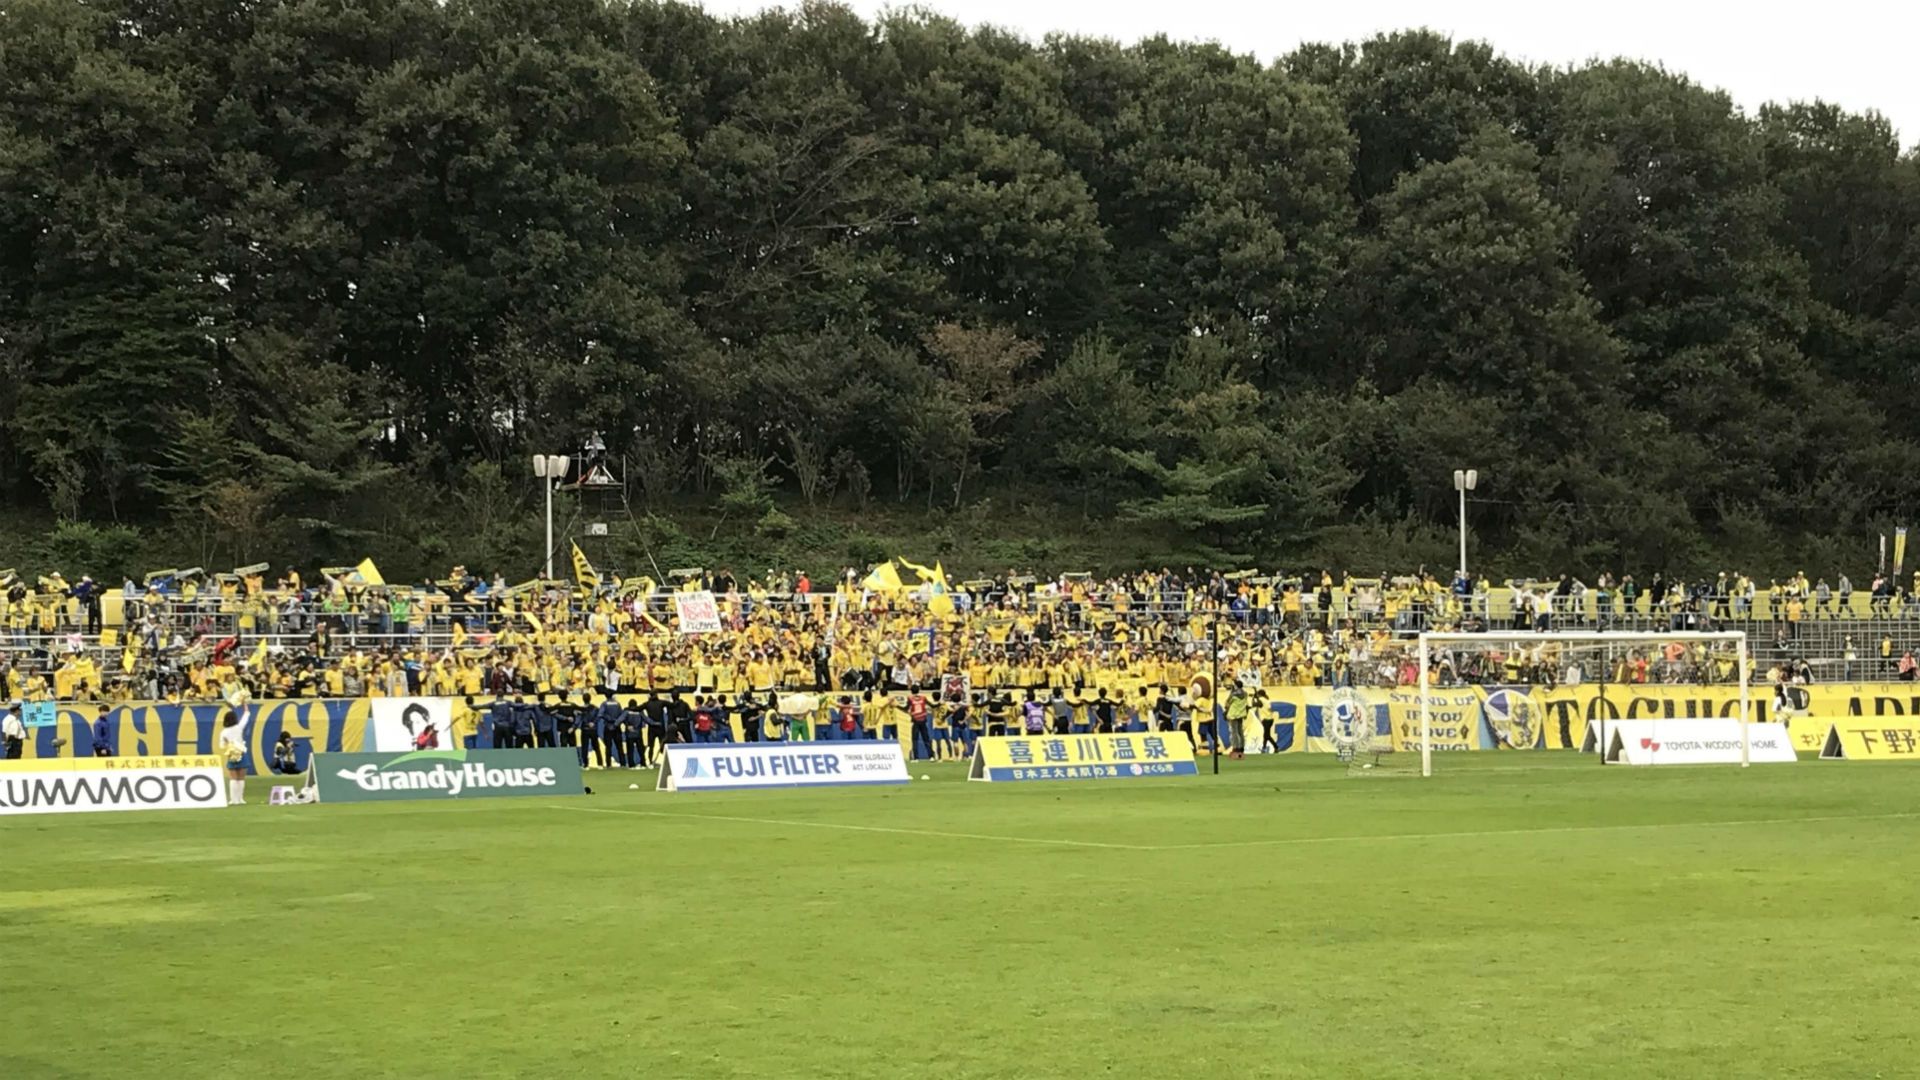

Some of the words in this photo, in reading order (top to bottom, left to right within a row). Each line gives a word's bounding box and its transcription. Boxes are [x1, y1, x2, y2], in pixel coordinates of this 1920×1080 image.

[1390, 692, 1448, 706] STAND
[1454, 695, 1476, 706] UP
[1429, 712, 1462, 722] YOU
[1006, 736, 1169, 764] 喜連川温泉
[1664, 741, 1702, 751] TOYOTA
[1751, 740, 1778, 749] HOME
[1846, 729, 1920, 754] 下野
[712, 756, 766, 777] FUJI
[769, 754, 841, 776] FILTER
[337, 762, 556, 794] GrandyHouse
[0, 774, 217, 807] UMAMOTO
